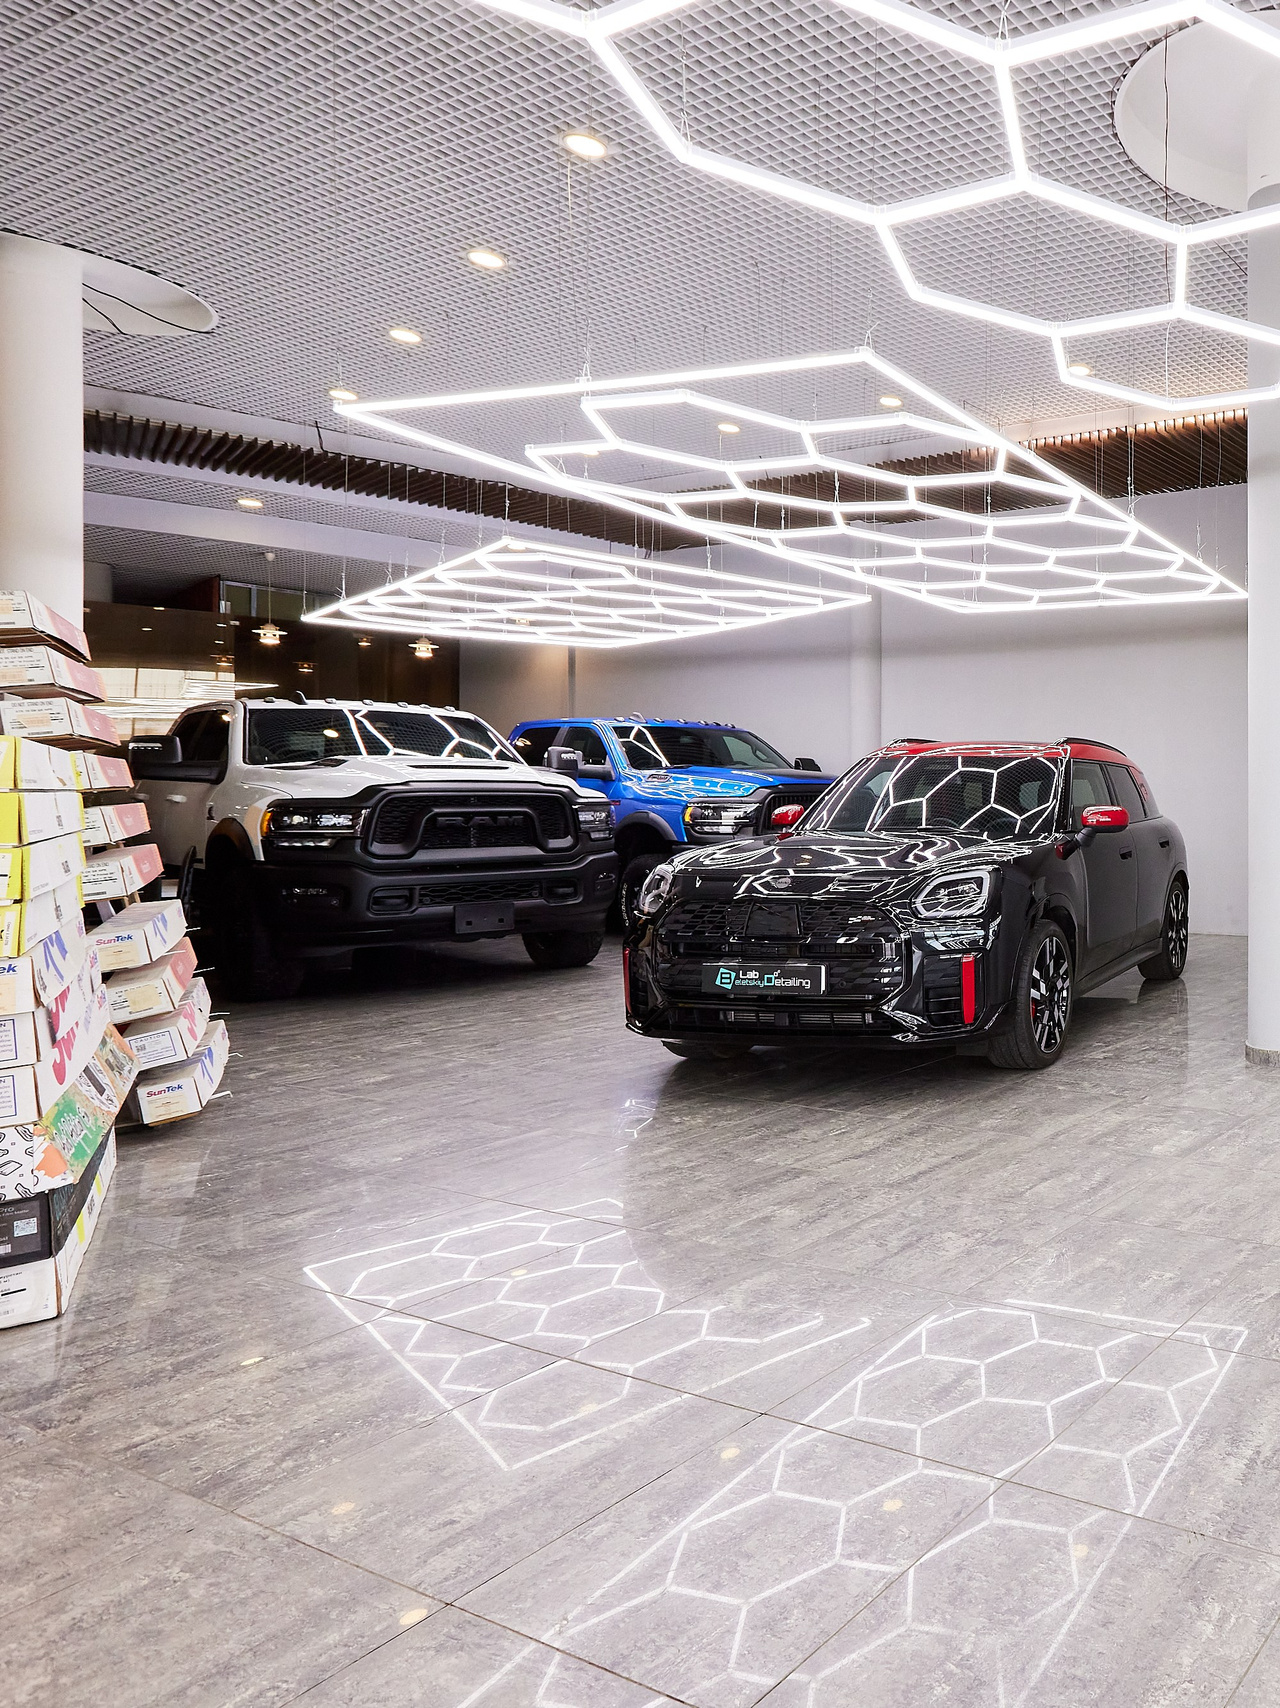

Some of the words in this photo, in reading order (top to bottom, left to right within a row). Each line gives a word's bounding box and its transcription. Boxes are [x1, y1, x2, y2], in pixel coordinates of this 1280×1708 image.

[436, 815, 525, 828] RAM
[95, 933, 134, 946] SunTek
[739, 969, 759, 979] Lab
[764, 974, 811, 989] Detailing
[134, 1033, 166, 1044] CAUTION
[146, 1083, 184, 1098] SunTek
